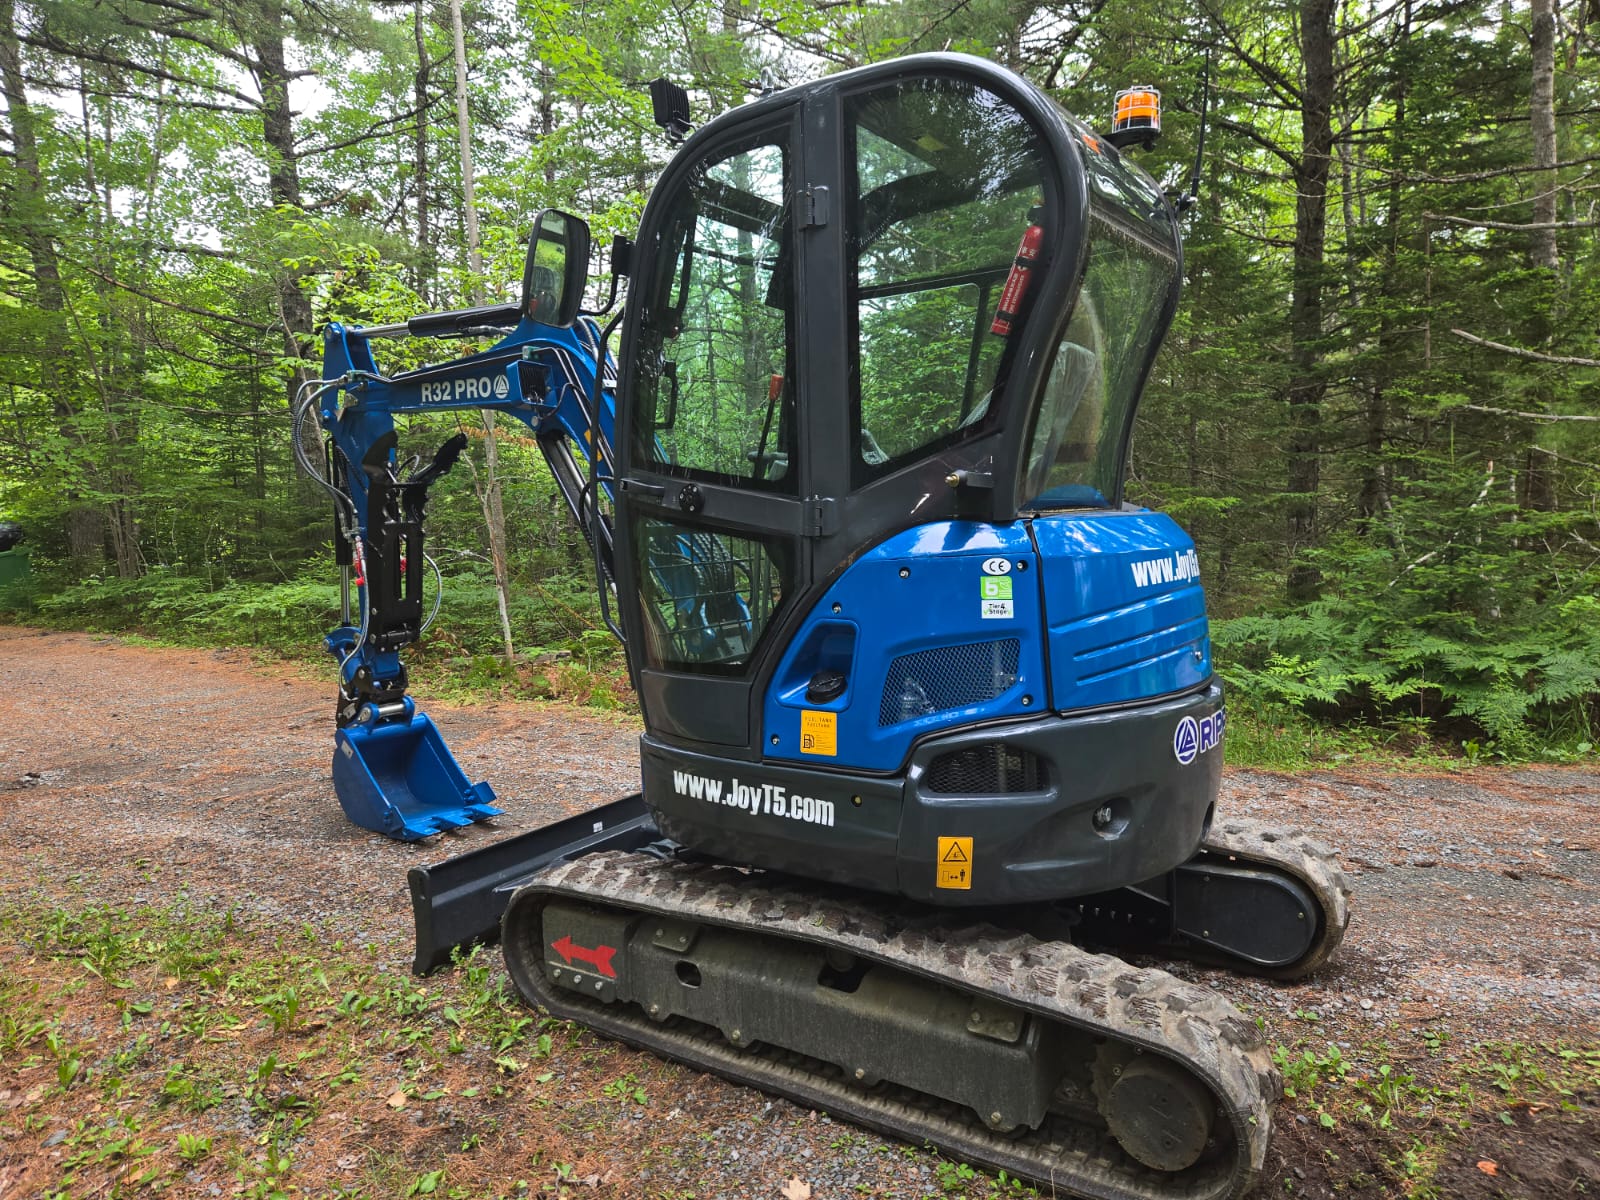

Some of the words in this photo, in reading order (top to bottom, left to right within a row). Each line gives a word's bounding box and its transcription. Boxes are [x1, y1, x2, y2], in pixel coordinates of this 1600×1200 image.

[421, 381, 451, 402] R32
[455, 377, 491, 399] PRO
[989, 560, 1005, 572] CE
[673, 770, 835, 827] www.JoyT5.com
